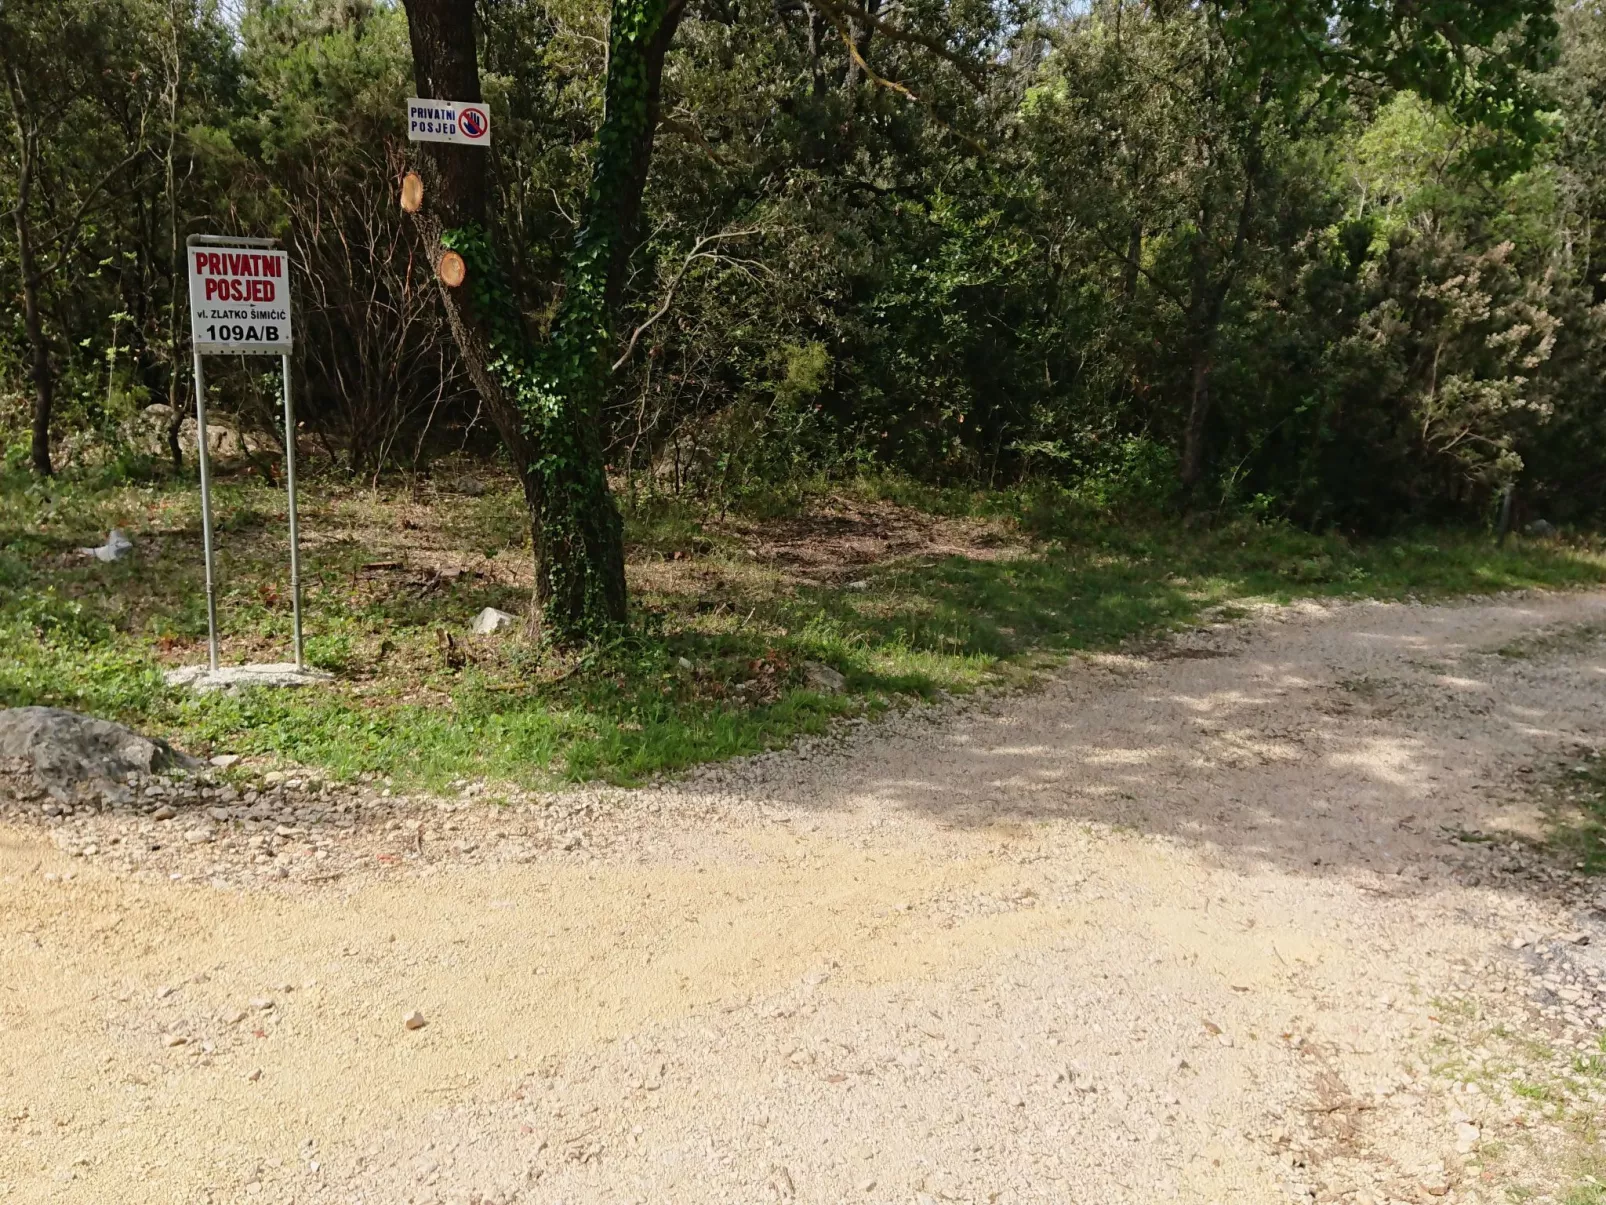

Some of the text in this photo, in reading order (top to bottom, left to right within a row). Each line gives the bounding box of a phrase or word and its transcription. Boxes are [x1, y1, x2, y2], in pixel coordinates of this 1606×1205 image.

[411, 107, 455, 121] PRIVATNI
[411, 121, 456, 134] POSJED
[195, 252, 282, 277] PRIVATNI
[205, 278, 275, 302] POSJED
[197, 310, 208, 319] vl.
[211, 310, 248, 319] ZLATKO
[206, 325, 279, 341] 109A/B
